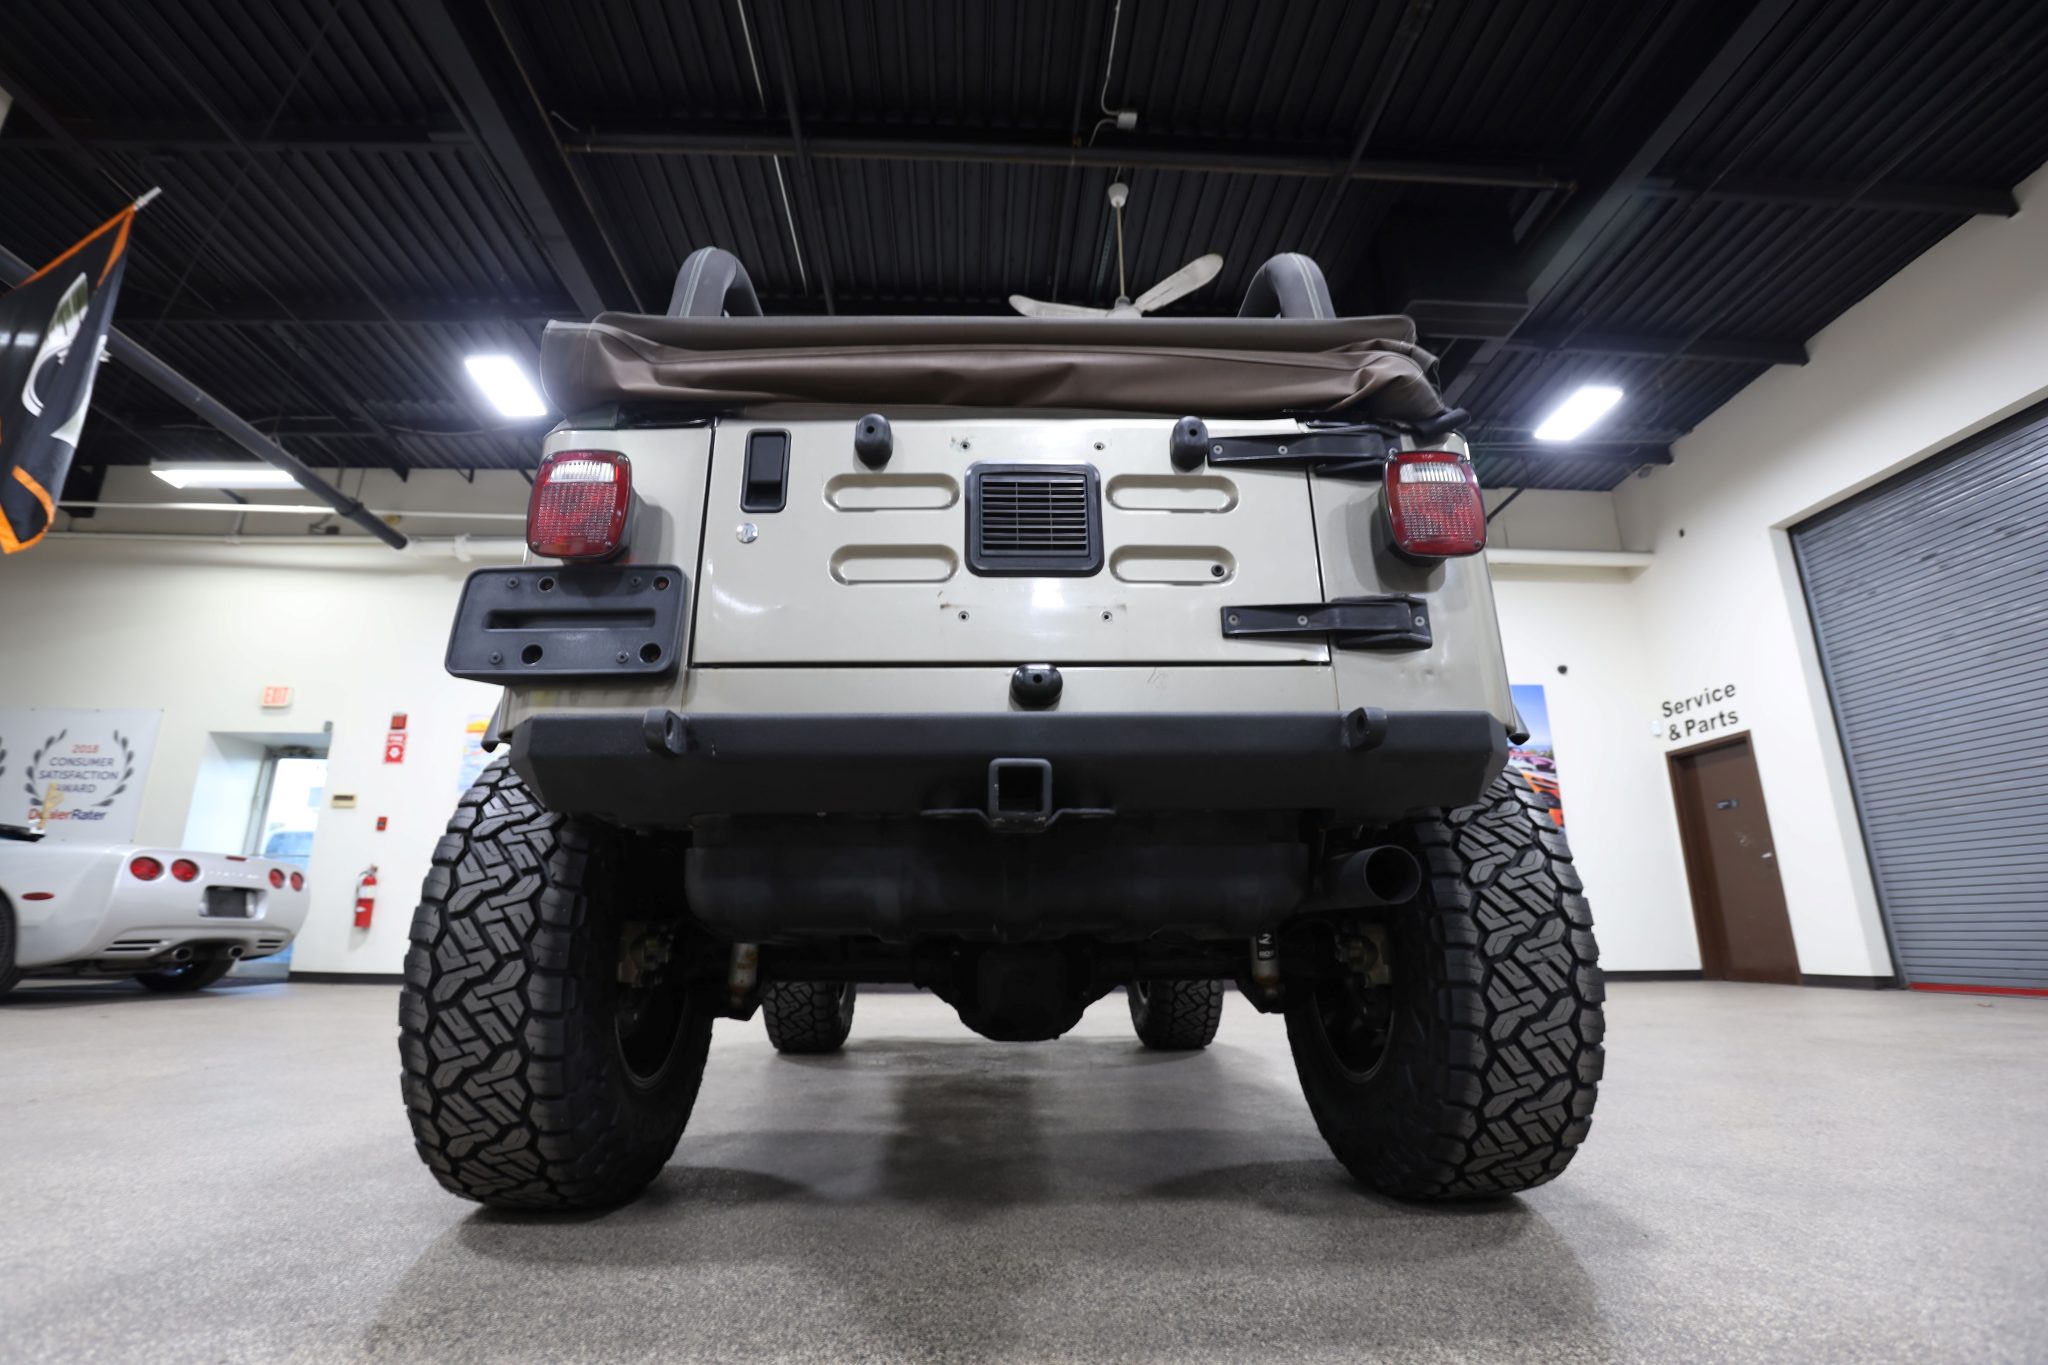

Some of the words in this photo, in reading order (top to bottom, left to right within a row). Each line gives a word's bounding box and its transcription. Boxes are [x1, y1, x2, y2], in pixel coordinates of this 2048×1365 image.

[1661, 683, 1736, 718] Service
[1668, 723, 1682, 741] &
[1685, 710, 1739, 737] Parts
[49, 757, 115, 767] CONSUMER
[38, 770, 119, 780] SATISFACTION
